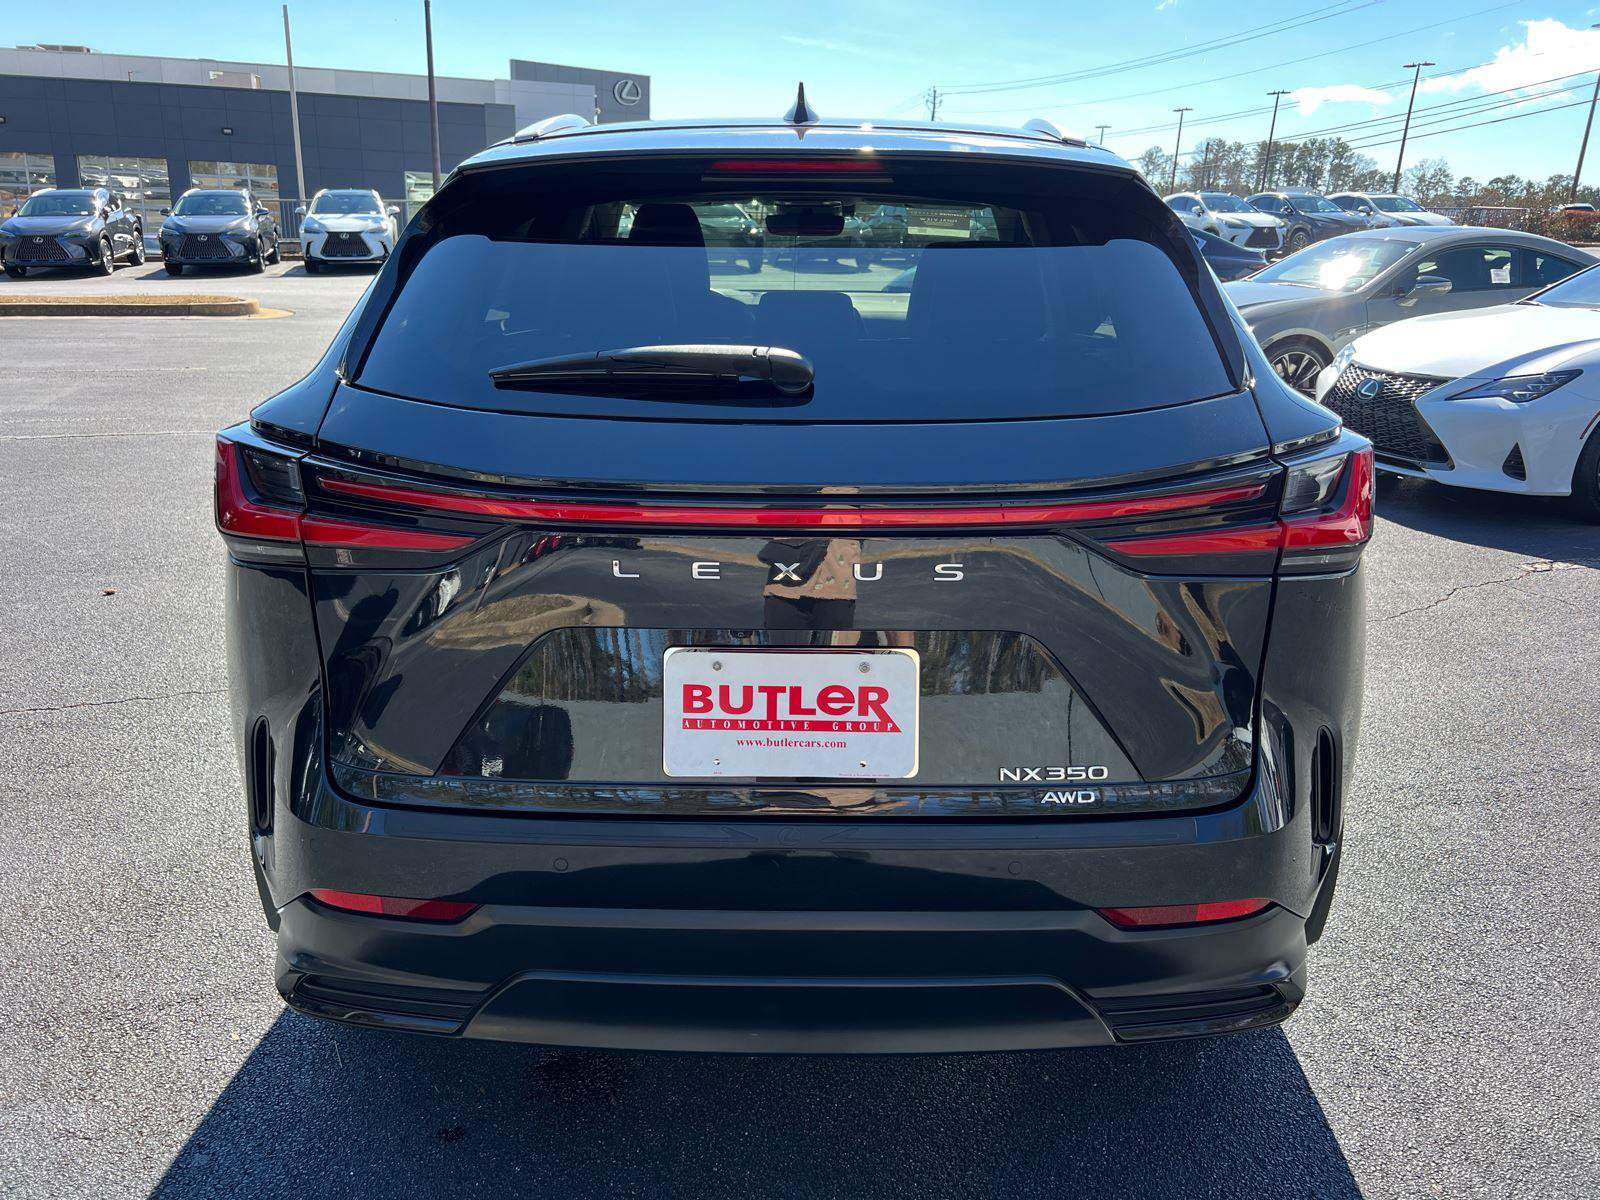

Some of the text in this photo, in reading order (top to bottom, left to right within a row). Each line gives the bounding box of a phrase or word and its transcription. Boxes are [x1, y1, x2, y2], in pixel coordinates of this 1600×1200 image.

[611, 559, 965, 582] LEXUS
[683, 720, 893, 731] AUTOMOTIVE GROUP
[736, 737, 847, 748] www.butlercars.com
[1040, 790, 1096, 804] AWD
